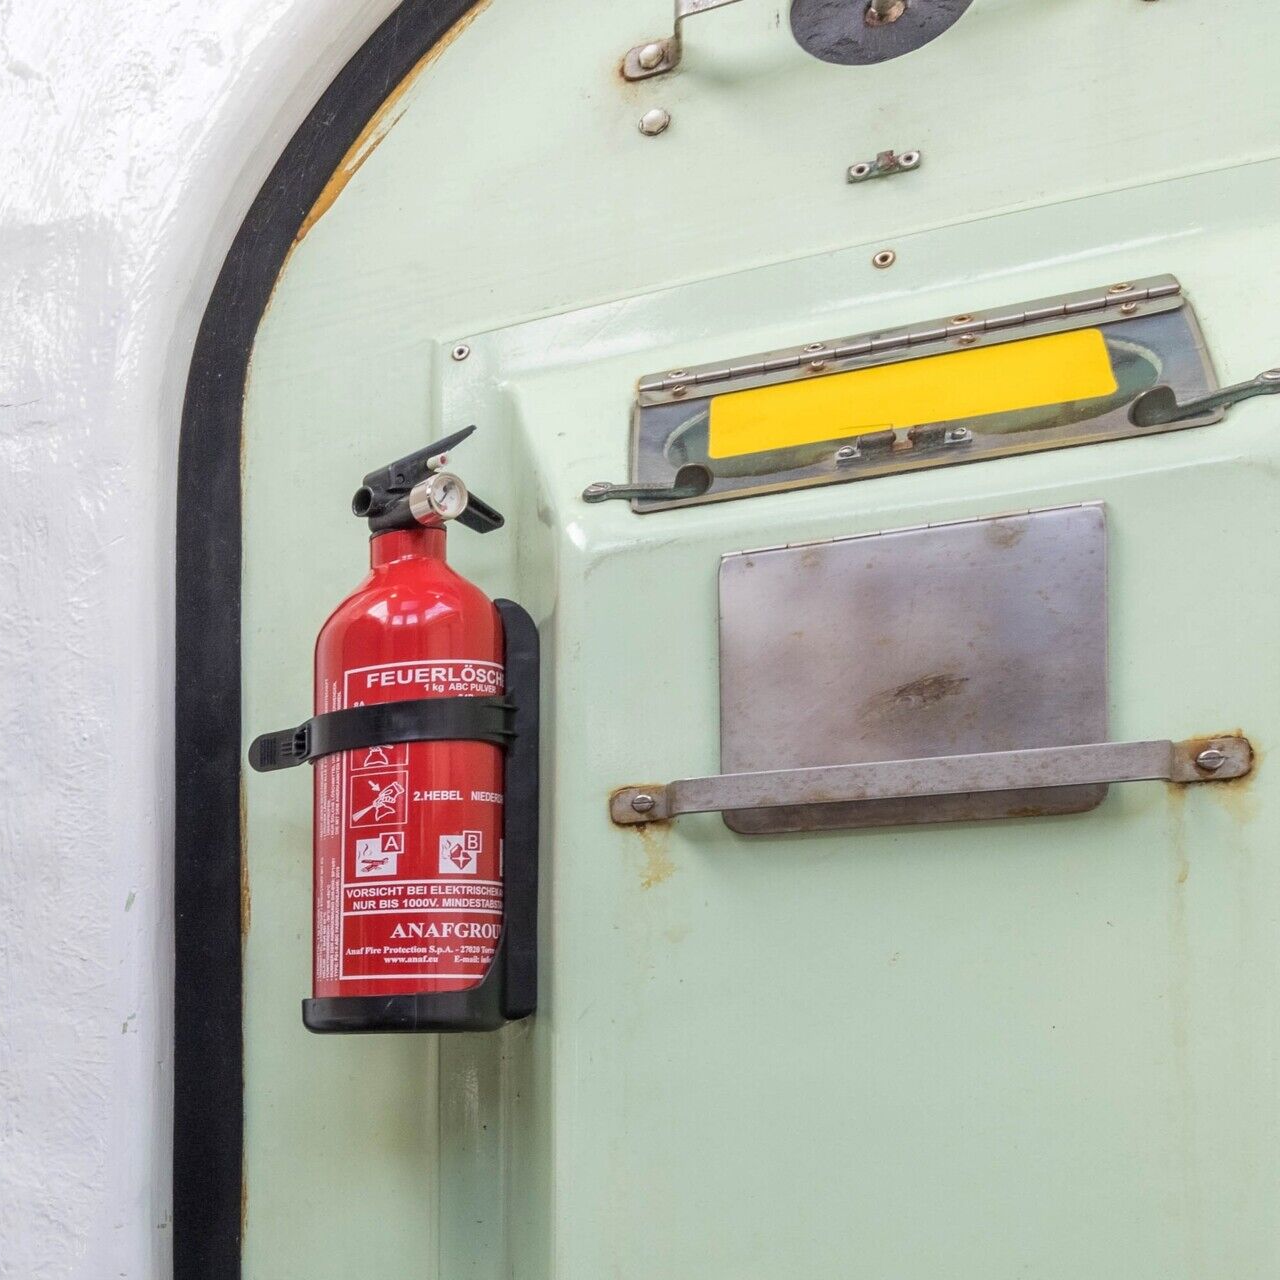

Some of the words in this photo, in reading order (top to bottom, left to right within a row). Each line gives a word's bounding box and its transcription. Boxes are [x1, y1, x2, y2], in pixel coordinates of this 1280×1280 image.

[432, 683, 445, 692] kg
[449, 682, 468, 691] ABC
[470, 683, 496, 694] PULVER
[413, 790, 463, 801] 2.HEBEL
[384, 836, 399, 850] A
[467, 834, 478, 849] B
[346, 886, 404, 898] VORSICHT
[407, 885, 427, 895] BEI
[353, 900, 377, 910] NUR
[379, 899, 399, 908] BIS
[403, 898, 439, 908] 1000V.
[390, 923, 501, 939] ANAFGROU
[345, 947, 364, 956] Anaf
[365, 947, 382, 955] Fire
[383, 945, 427, 954] Protection
[428, 945, 453, 955] S.p.A.
[384, 955, 438, 963] www.anaf.eu
[454, 955, 480, 963] E-mail:
